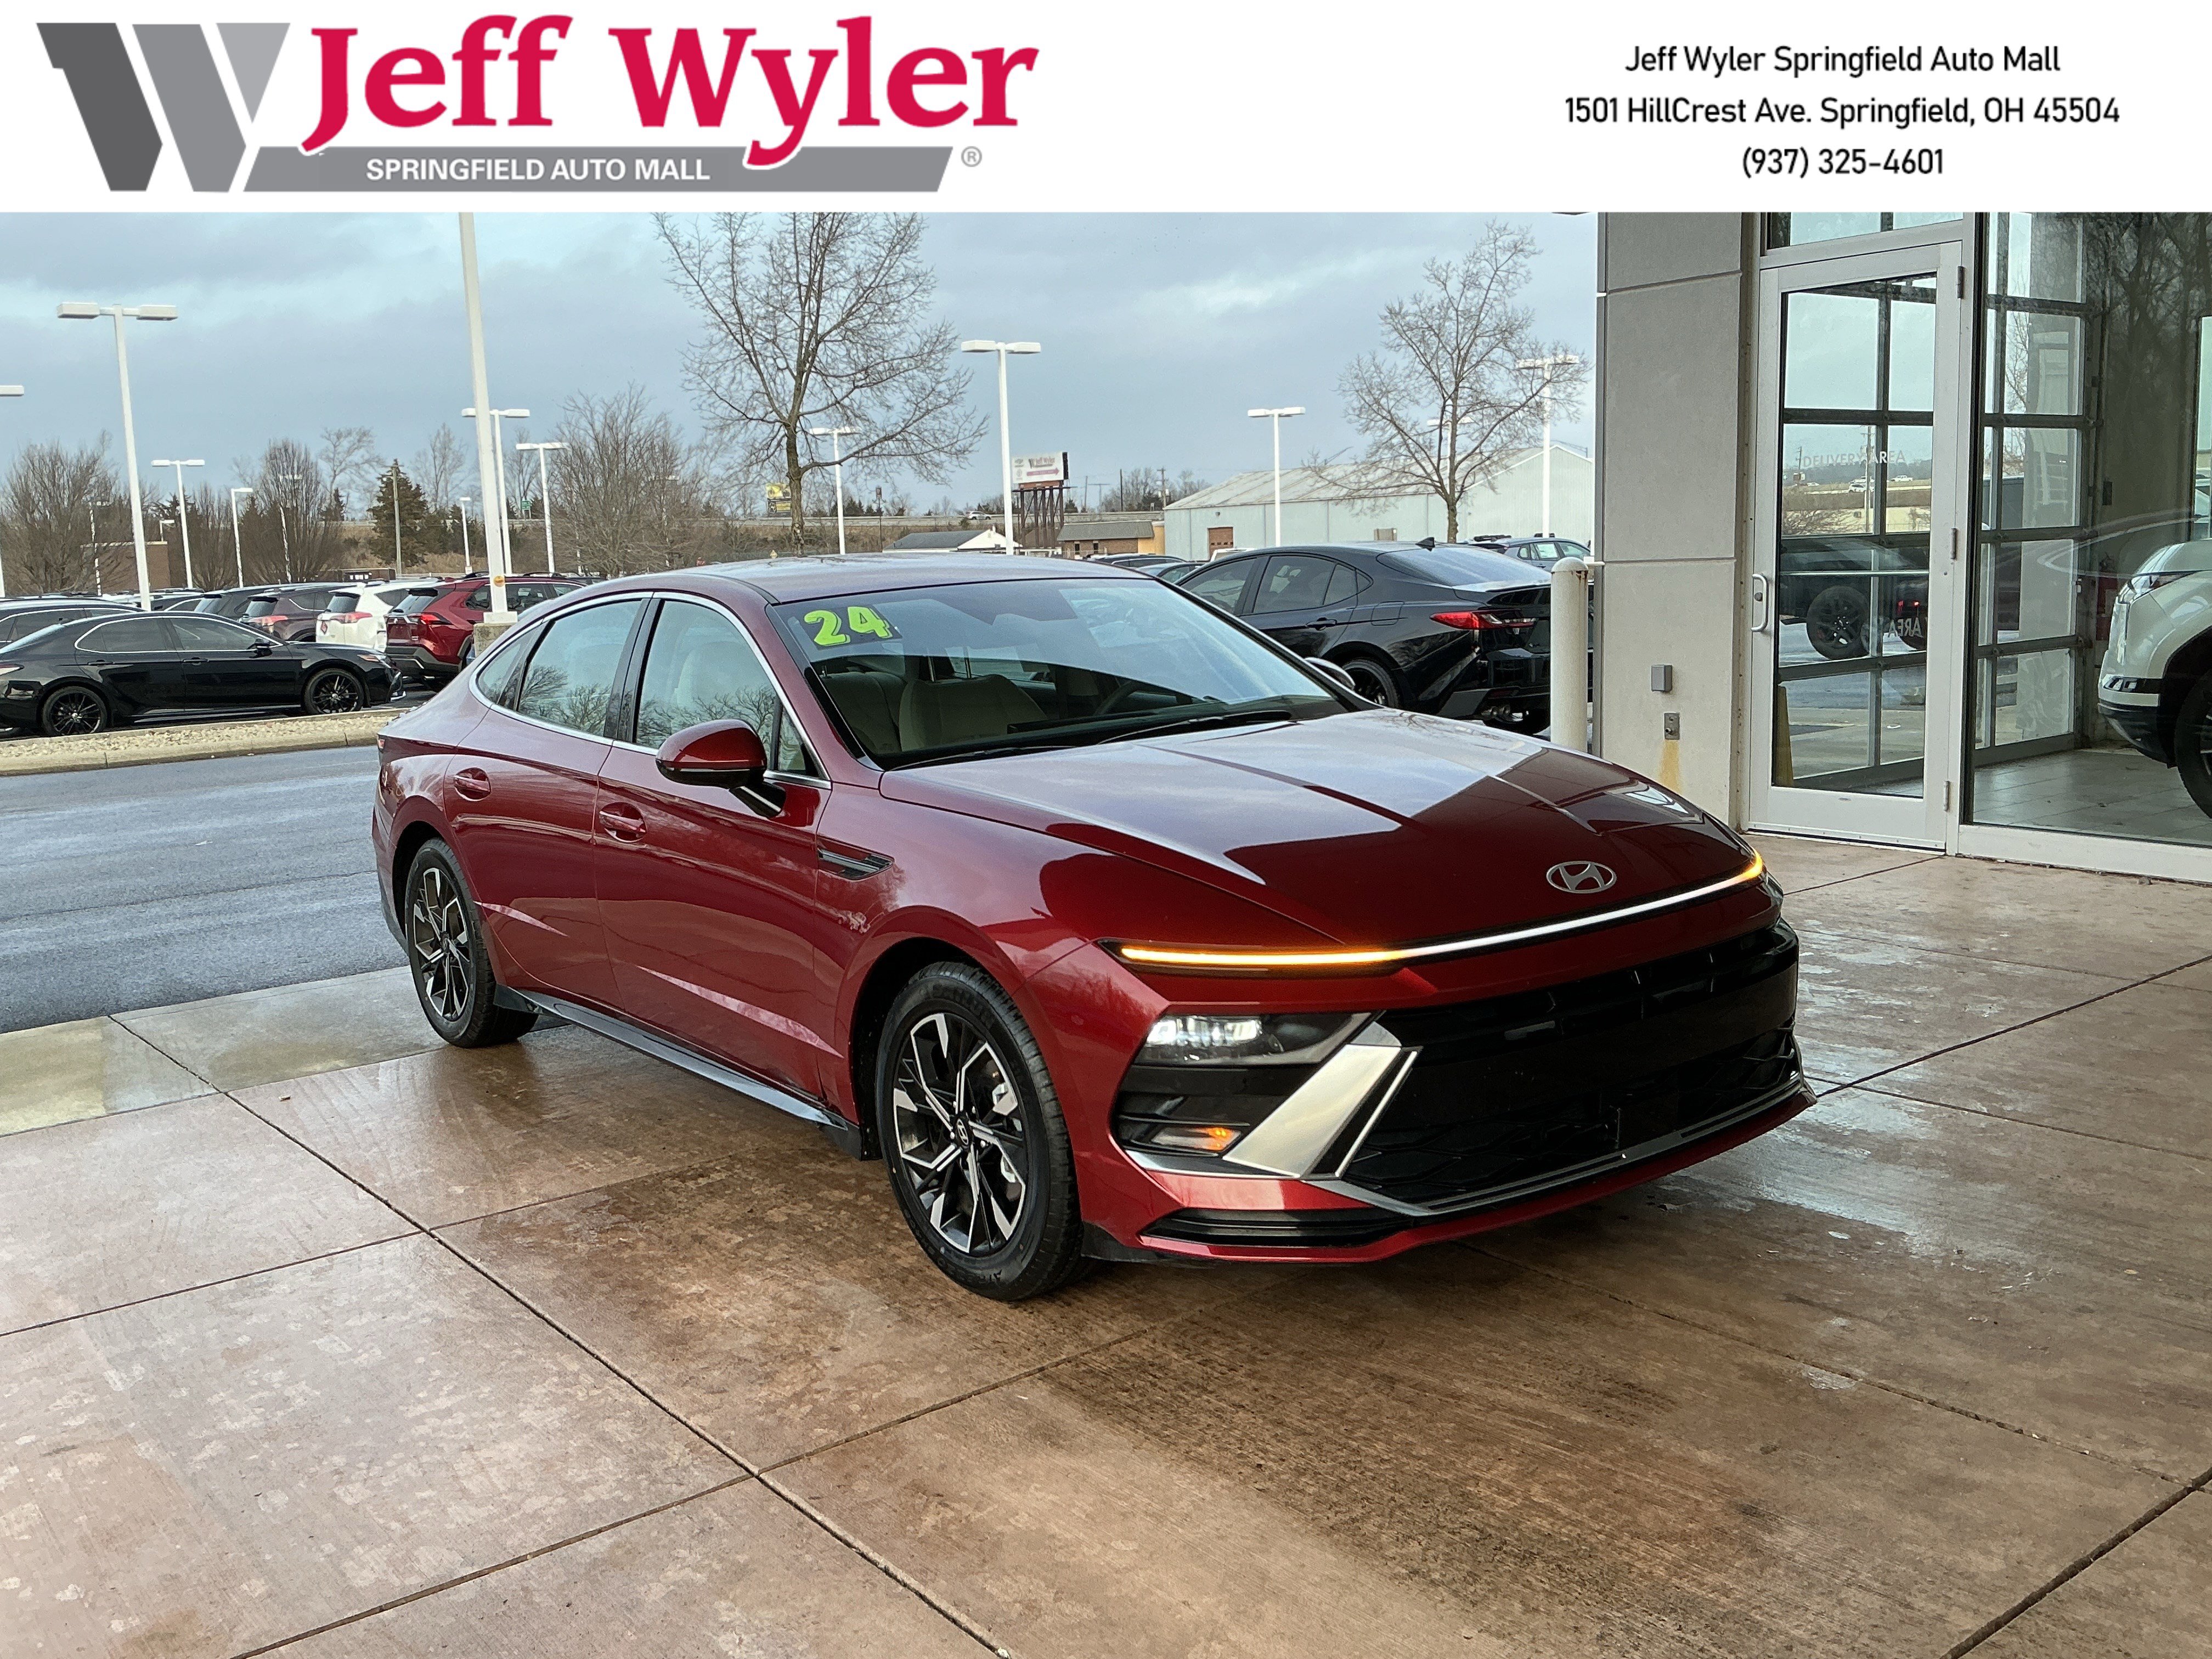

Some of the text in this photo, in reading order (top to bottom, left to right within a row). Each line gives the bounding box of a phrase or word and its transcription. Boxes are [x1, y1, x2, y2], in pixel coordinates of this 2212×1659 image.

[1803, 450, 1905, 467] DELIVERY AREA
[804, 606, 894, 646] 24
